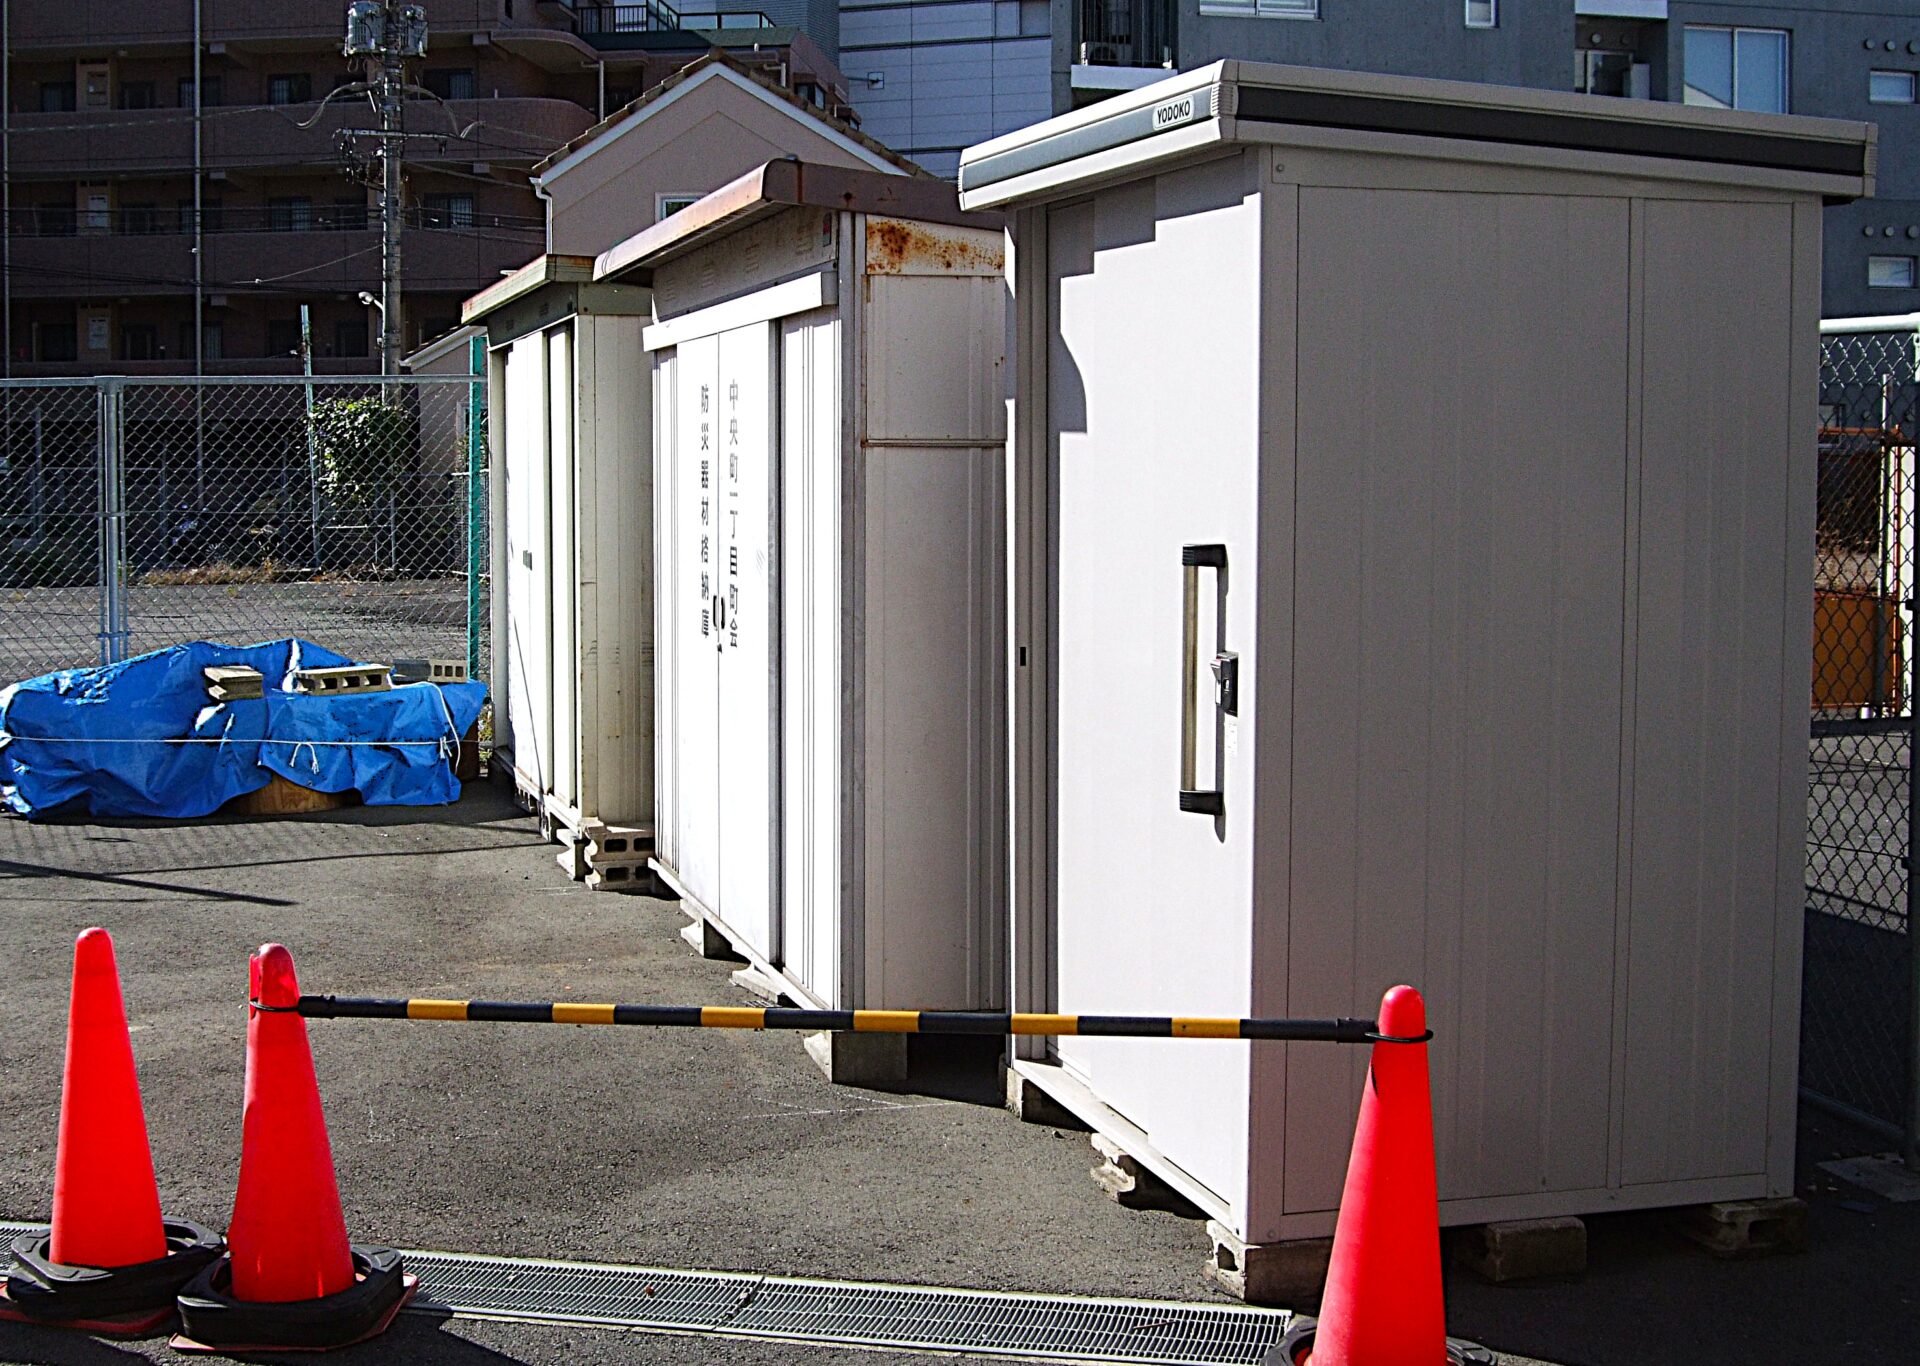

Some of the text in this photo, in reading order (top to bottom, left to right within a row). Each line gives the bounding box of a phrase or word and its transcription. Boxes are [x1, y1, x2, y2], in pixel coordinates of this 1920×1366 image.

[1157, 101, 1190, 124] YODOKO
[701, 383, 709, 638] 防災器材格納庫
[729, 378, 739, 648] 中央町一丁目町会
